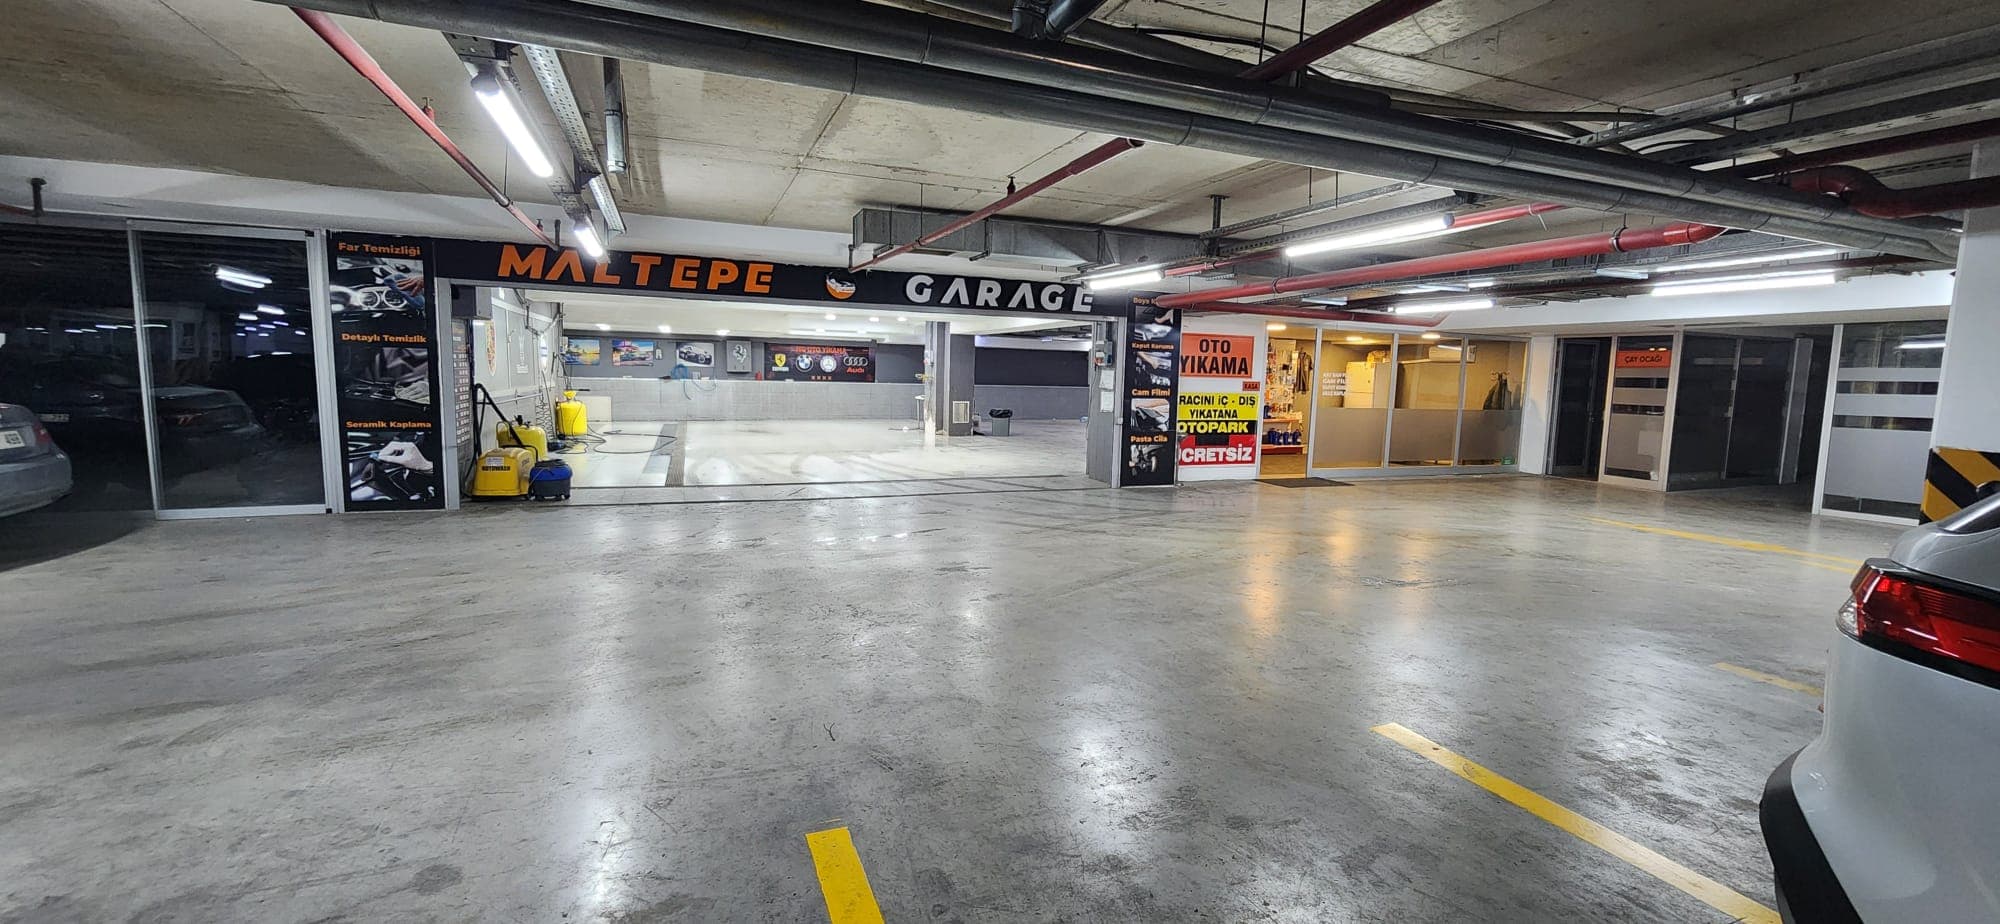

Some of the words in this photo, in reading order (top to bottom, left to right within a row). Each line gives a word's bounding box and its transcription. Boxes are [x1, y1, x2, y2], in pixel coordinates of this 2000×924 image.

[338, 242, 360, 252] Far
[362, 243, 421, 257] Temizliği
[498, 244, 774, 293] MALTEPE
[905, 274, 1094, 313] GARAGE
[341, 333, 381, 343] Detaylı
[383, 334, 427, 343] Temizlik
[1199, 338, 1231, 354] OTO
[1180, 355, 1249, 375] YIKAMA
[1131, 388, 1150, 396] Cam
[1151, 388, 1171, 396] Filmi
[1179, 395, 1215, 405] RACINI
[1238, 396, 1256, 408] DIŞ
[1190, 408, 1238, 419] YIKATANA
[345, 420, 387, 428] Seramik
[389, 420, 432, 430] Kaplama
[1177, 421, 1249, 434] OTOPARK
[1153, 435, 1169, 443] Cila
